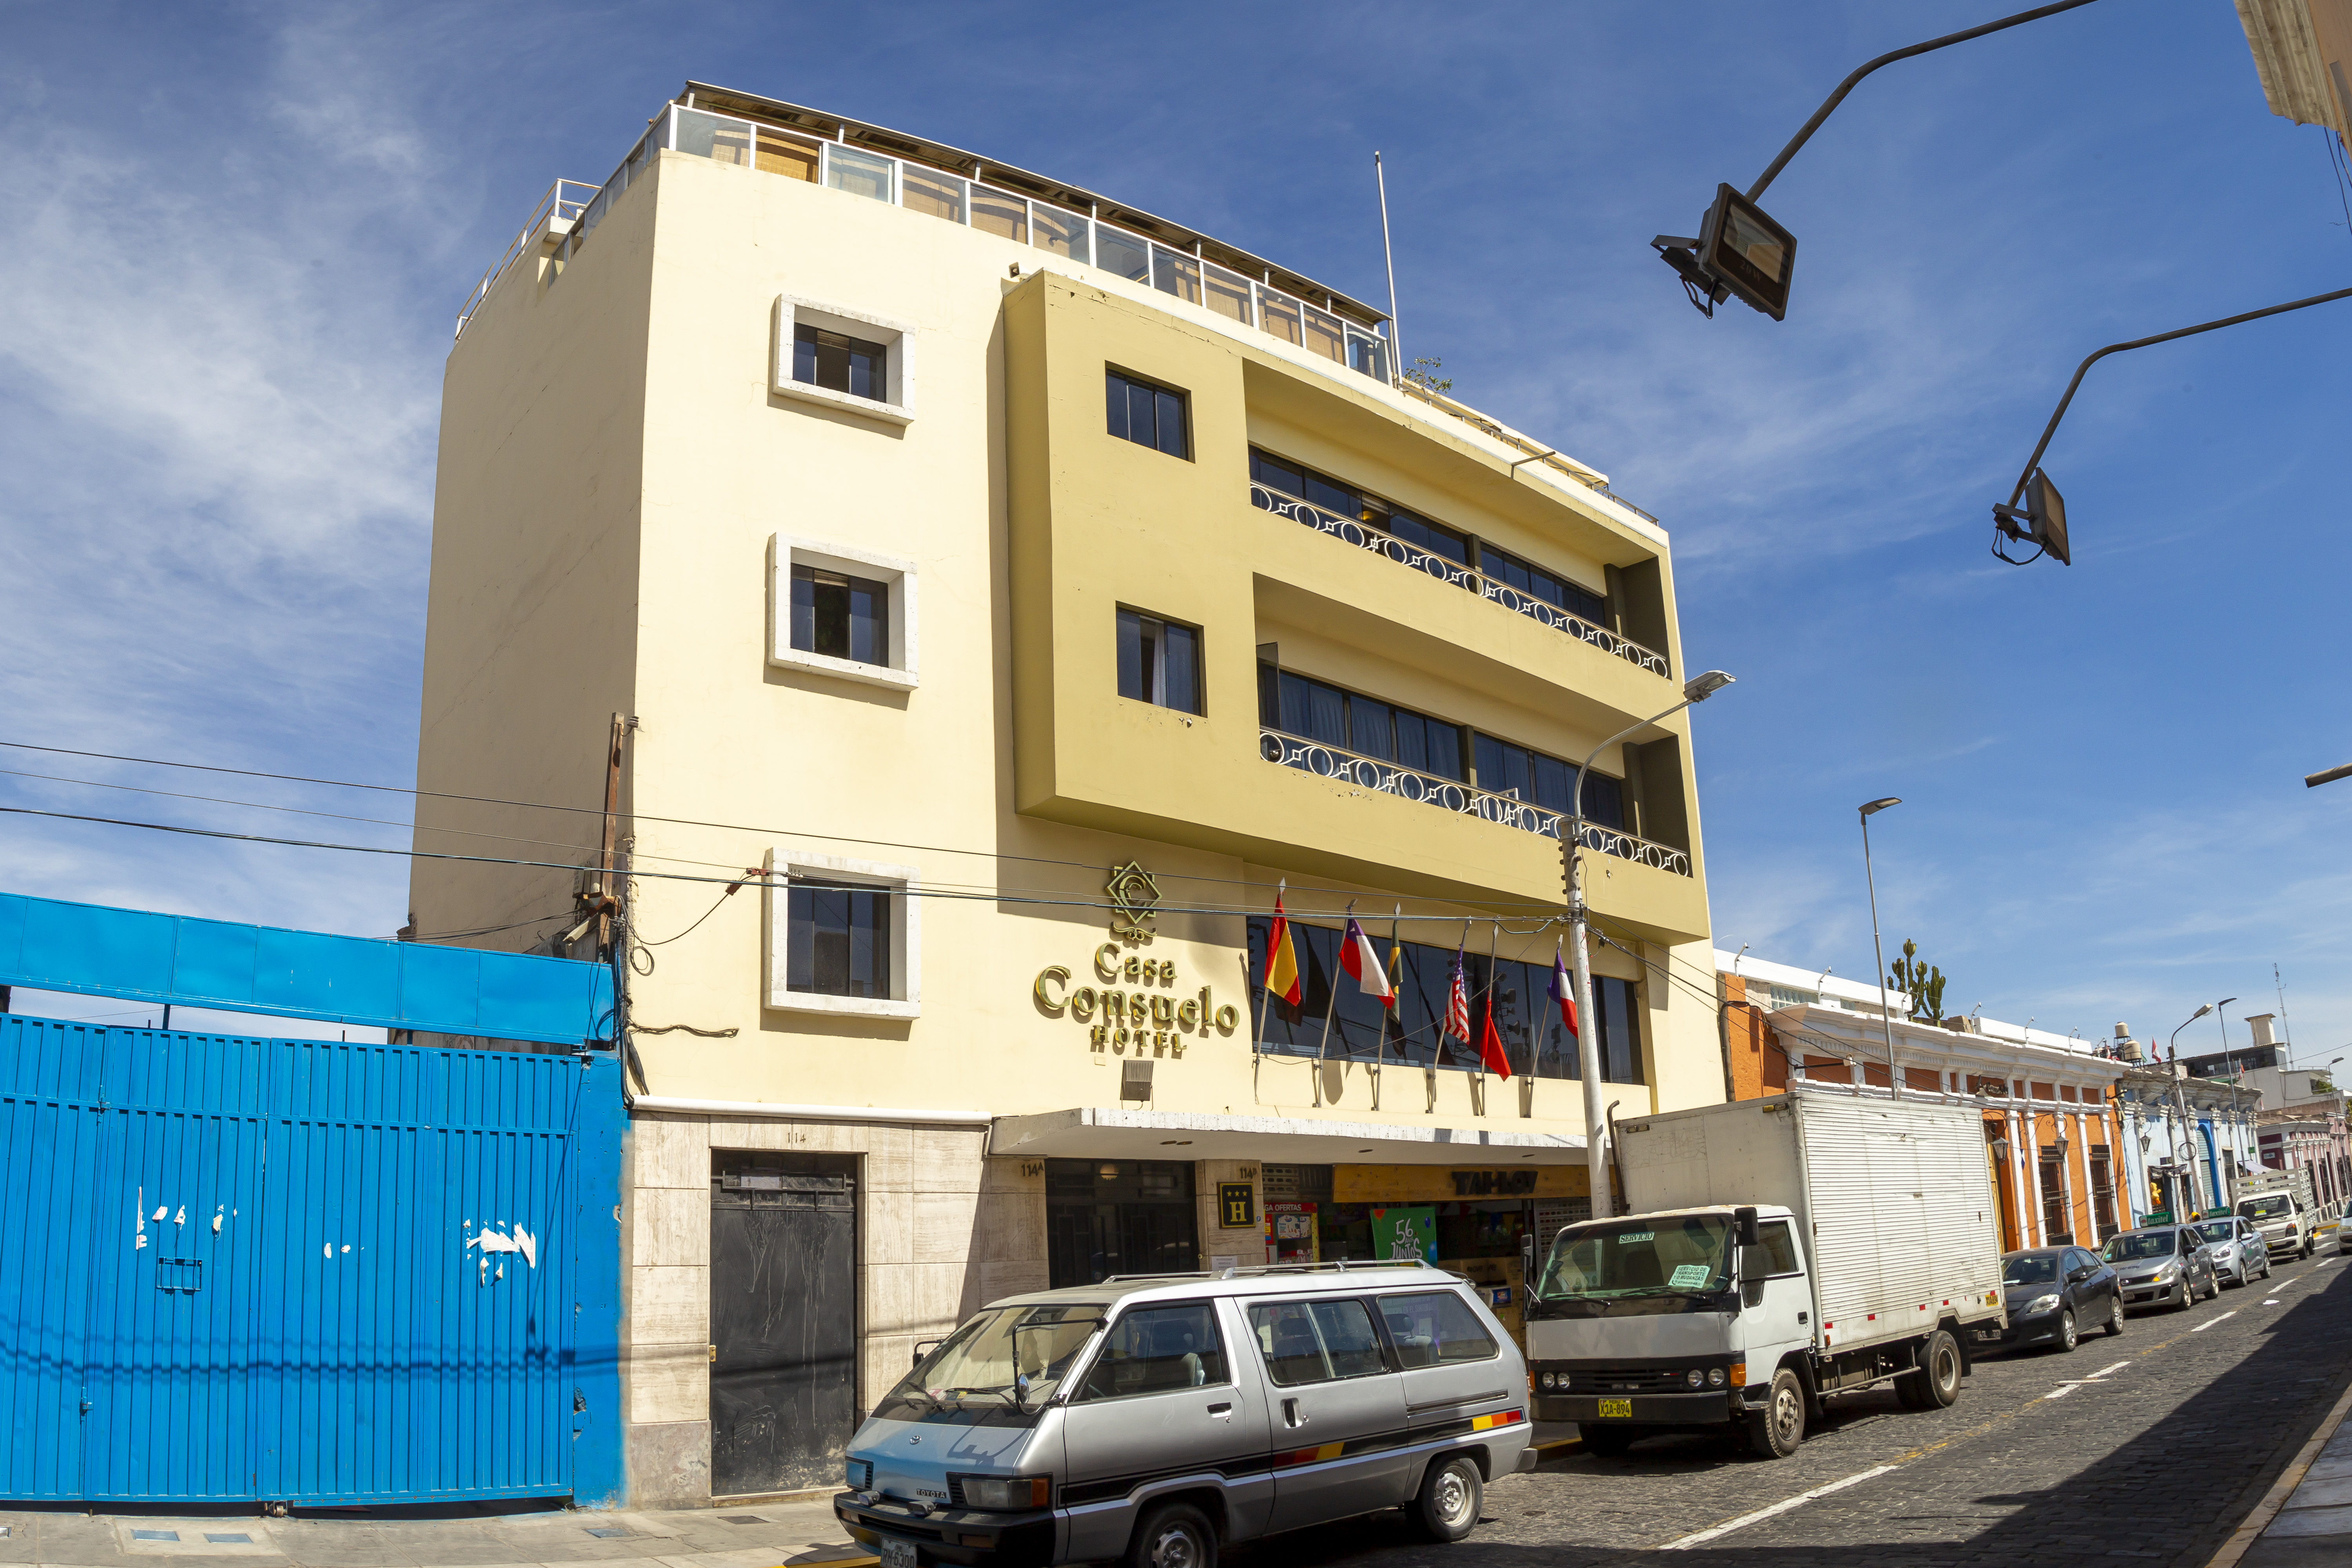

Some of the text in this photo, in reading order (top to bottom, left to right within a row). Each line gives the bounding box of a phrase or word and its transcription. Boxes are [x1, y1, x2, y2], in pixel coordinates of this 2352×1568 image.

[1096, 942, 1178, 979] Casa
[1035, 965, 1240, 1029] Consuelo
[1092, 1024, 1187, 1051] HOTEL
[788, 1132, 806, 1143] 114
[1021, 1161, 1044, 1177] 114A
[1229, 1201, 1247, 1222] H
[2209, 1207, 2227, 1217] taxitel
[2147, 1215, 2169, 1225] taxitel
[1396, 1218, 1413, 1244] 56
[1620, 1232, 1653, 1242] SERVICIO
[1389, 1238, 1423, 1260] JUNTOS
[1600, 1404, 1630, 1414] X1A-894
[916, 1489, 945, 1498] TOYOTA
